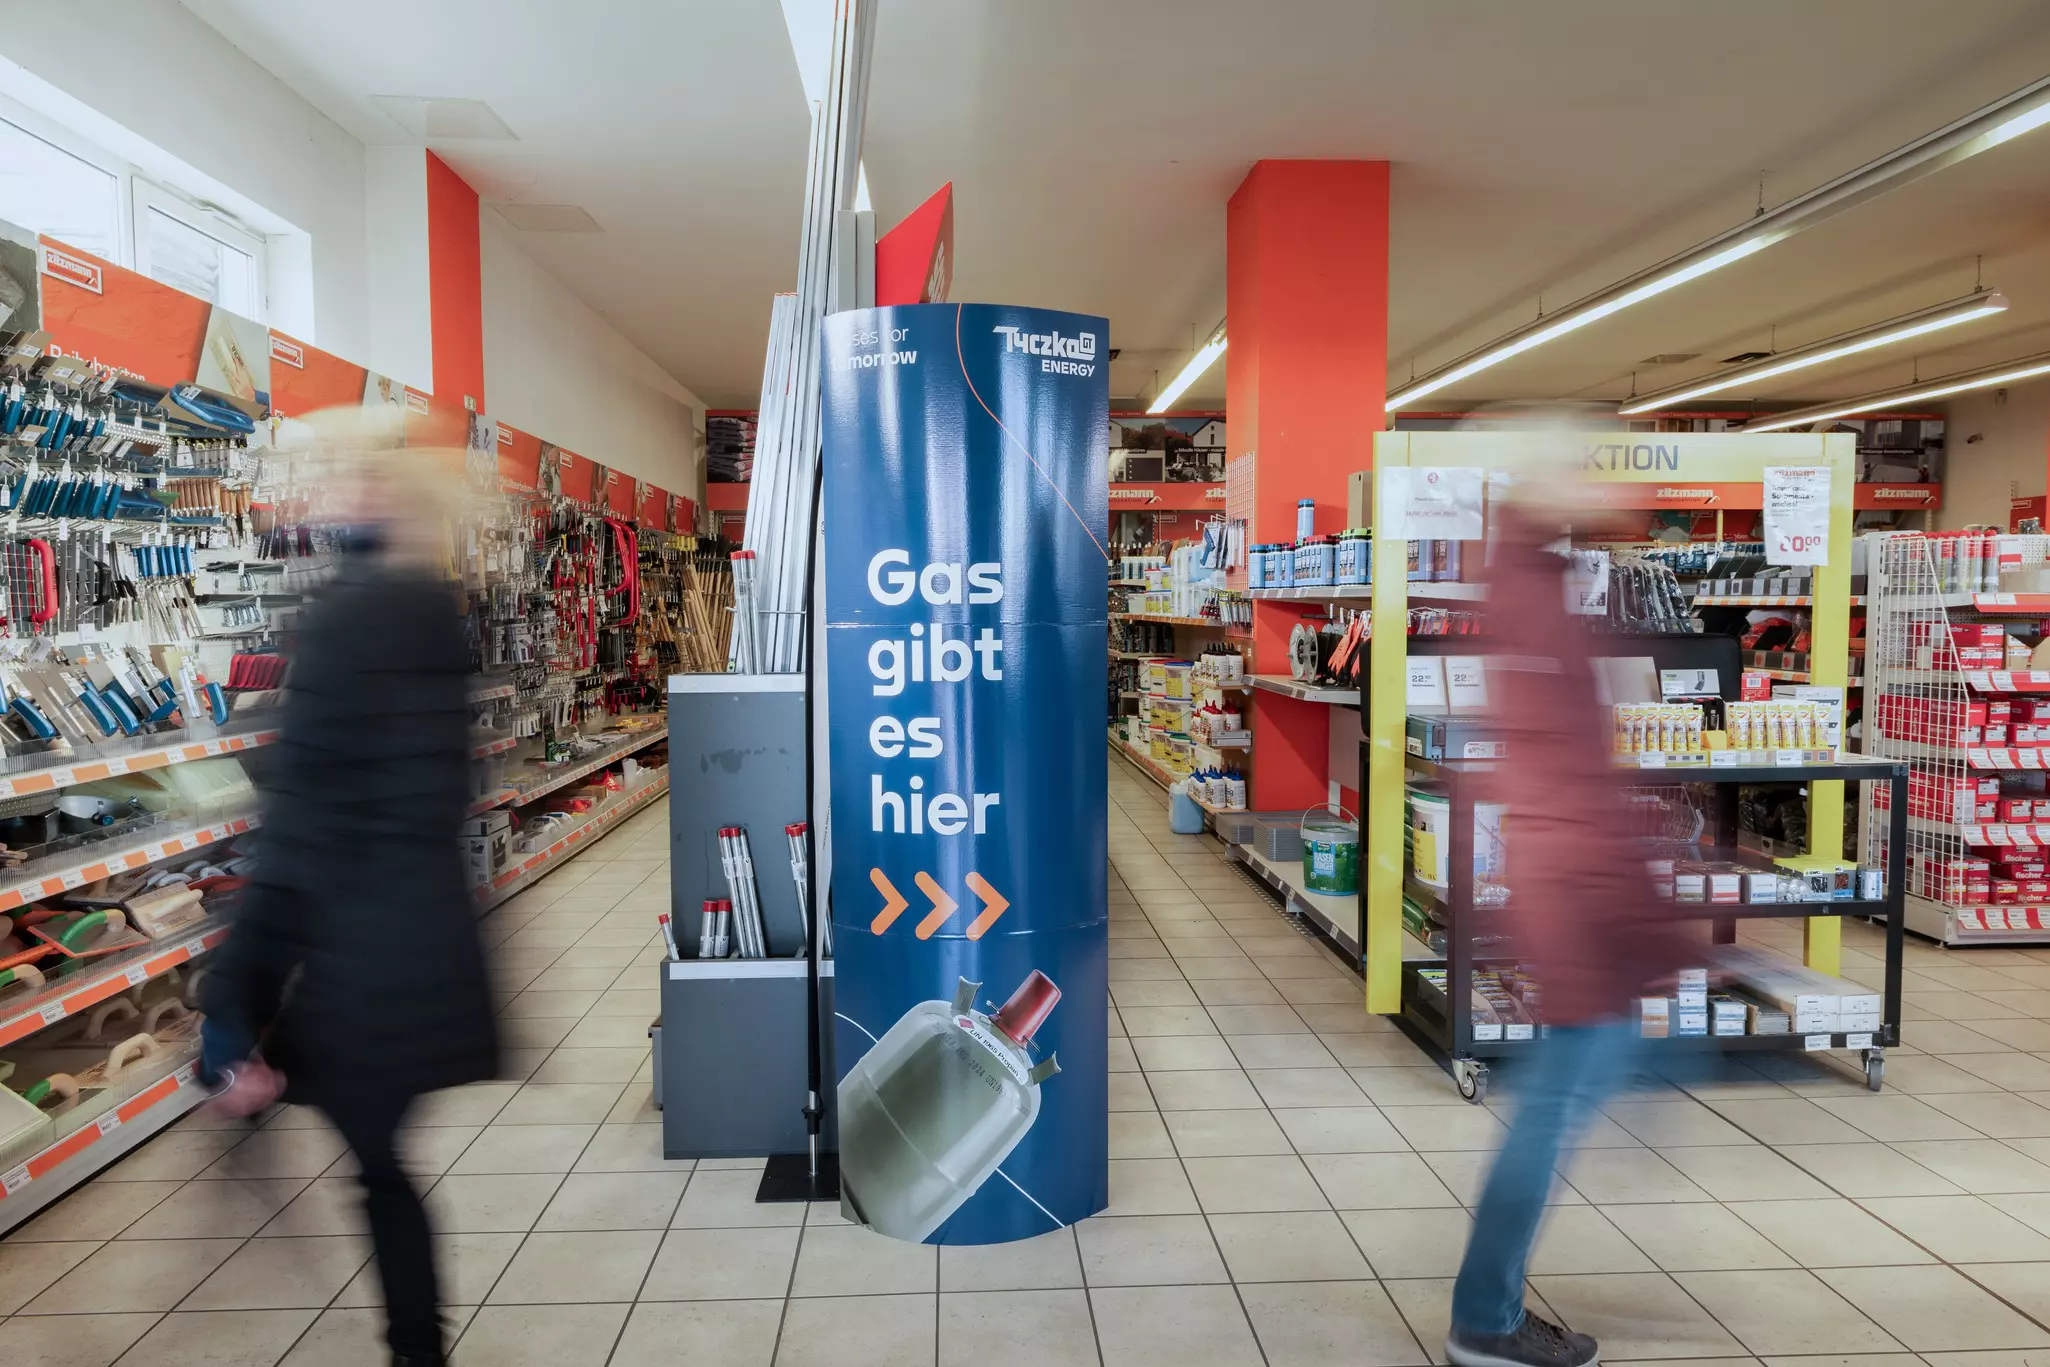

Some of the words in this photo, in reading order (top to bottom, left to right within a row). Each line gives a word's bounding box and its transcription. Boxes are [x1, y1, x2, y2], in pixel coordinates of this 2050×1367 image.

[992, 325, 1096, 361] Tyczka
[1041, 359, 1095, 377] ENERGY
[1575, 444, 1679, 470] KTION
[1109, 490, 1154, 498] zmann
[1874, 488, 1930, 497] zitzmann
[867, 548, 1004, 606] Gas
[868, 622, 1003, 696] gibt
[869, 715, 943, 758] es
[872, 774, 1000, 835] hier
[2005, 854, 2032, 862] fischer
[970, 1030, 982, 1039] UN
[983, 1040, 998, 1054] 1965
[998, 1052, 1019, 1077] Propan
